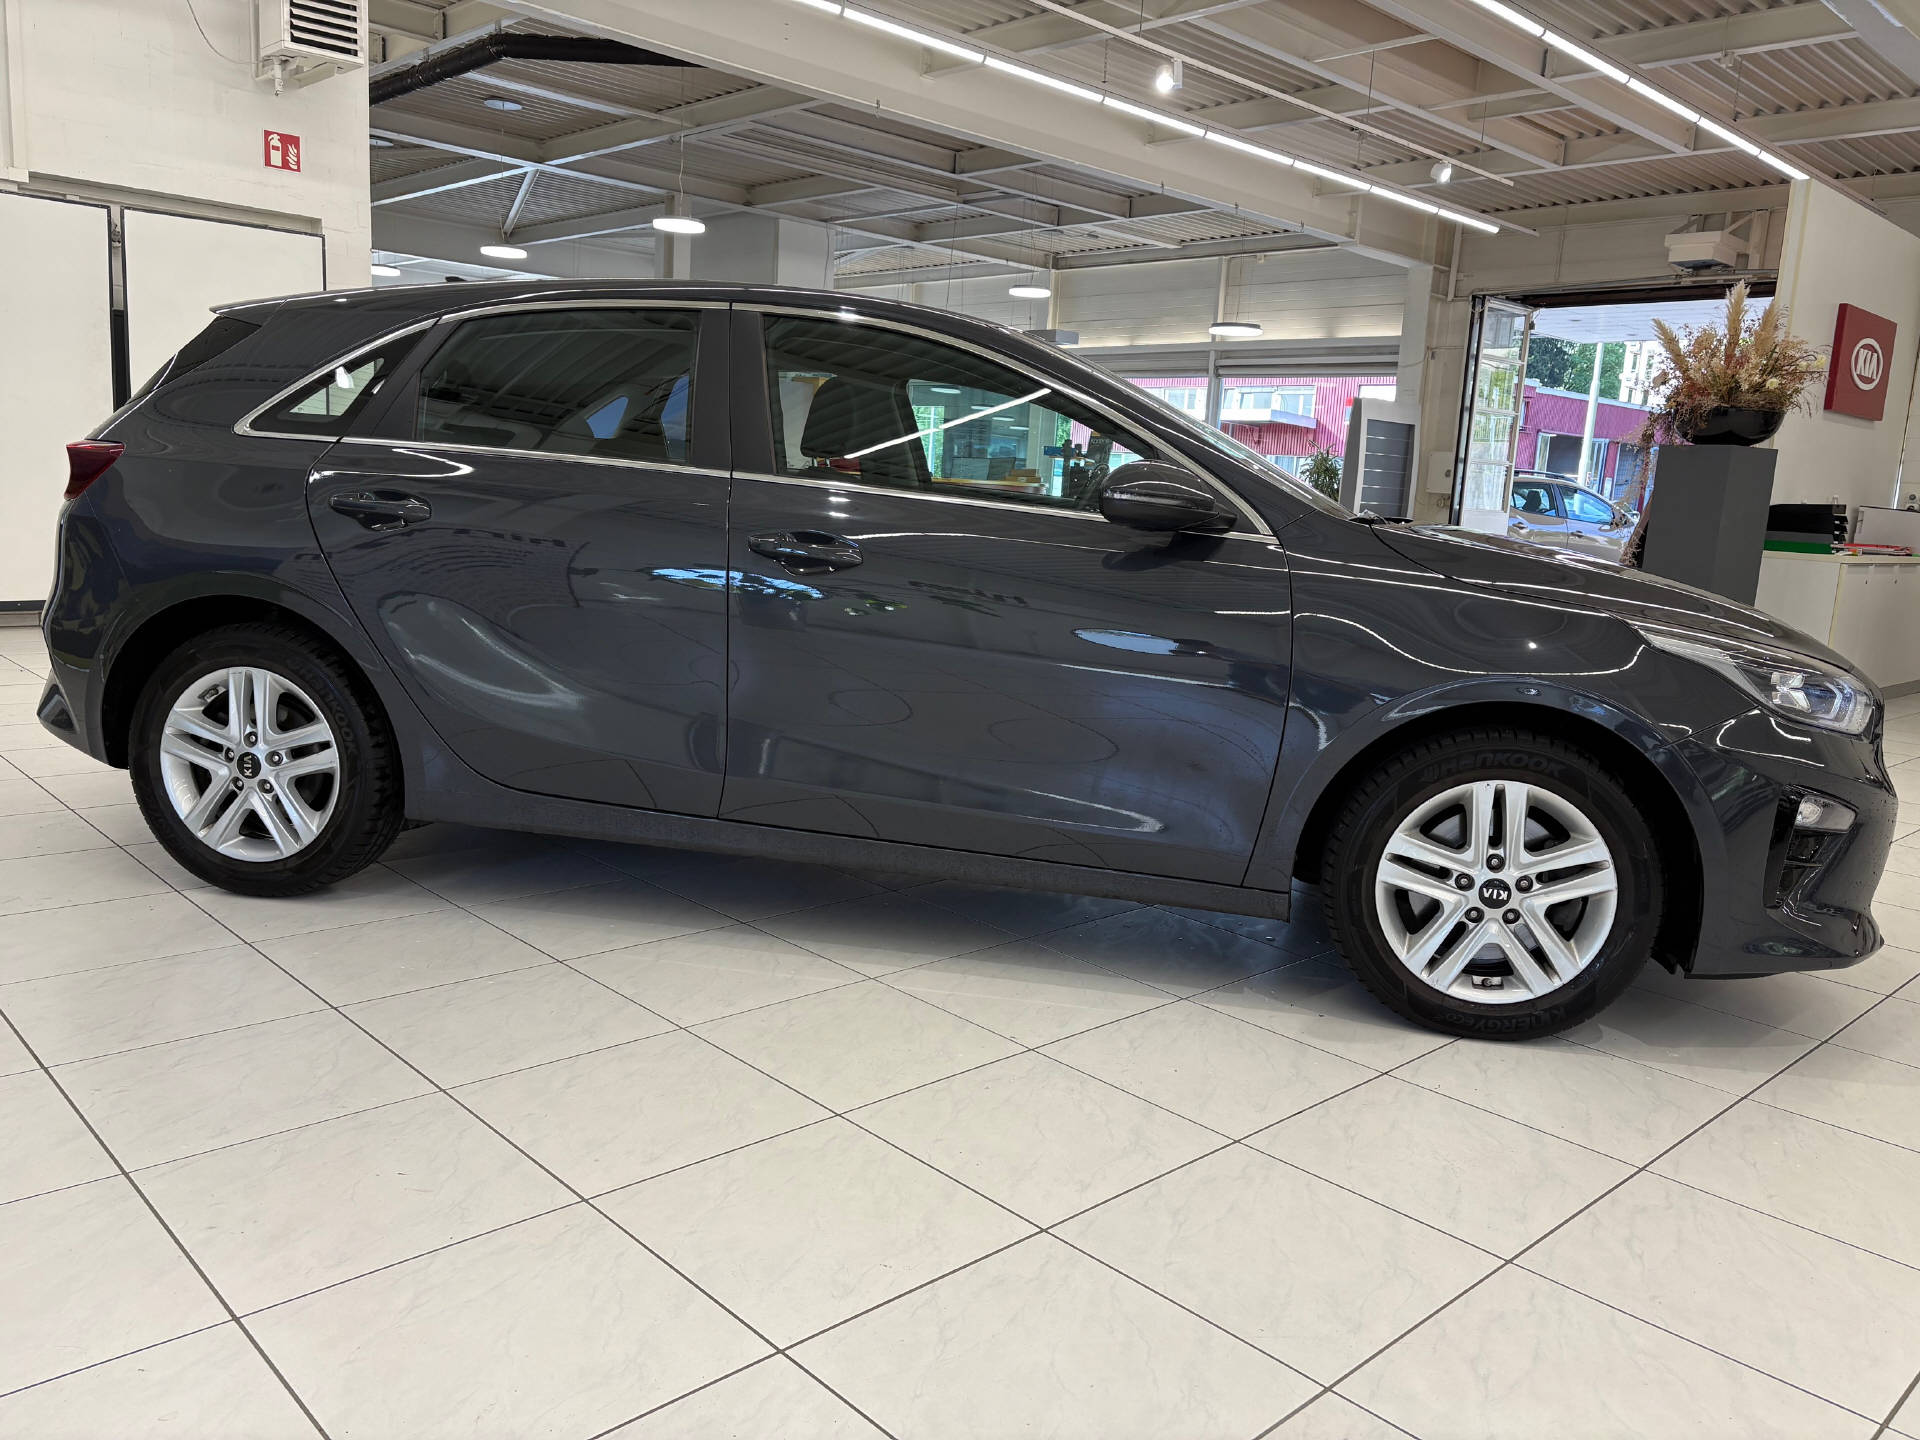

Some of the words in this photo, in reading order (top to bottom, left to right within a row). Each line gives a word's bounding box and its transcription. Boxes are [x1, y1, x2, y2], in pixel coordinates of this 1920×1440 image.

[1855, 348, 1878, 380] KIA
[243, 754, 253, 777] KIA
[1482, 887, 1509, 901] KIA
